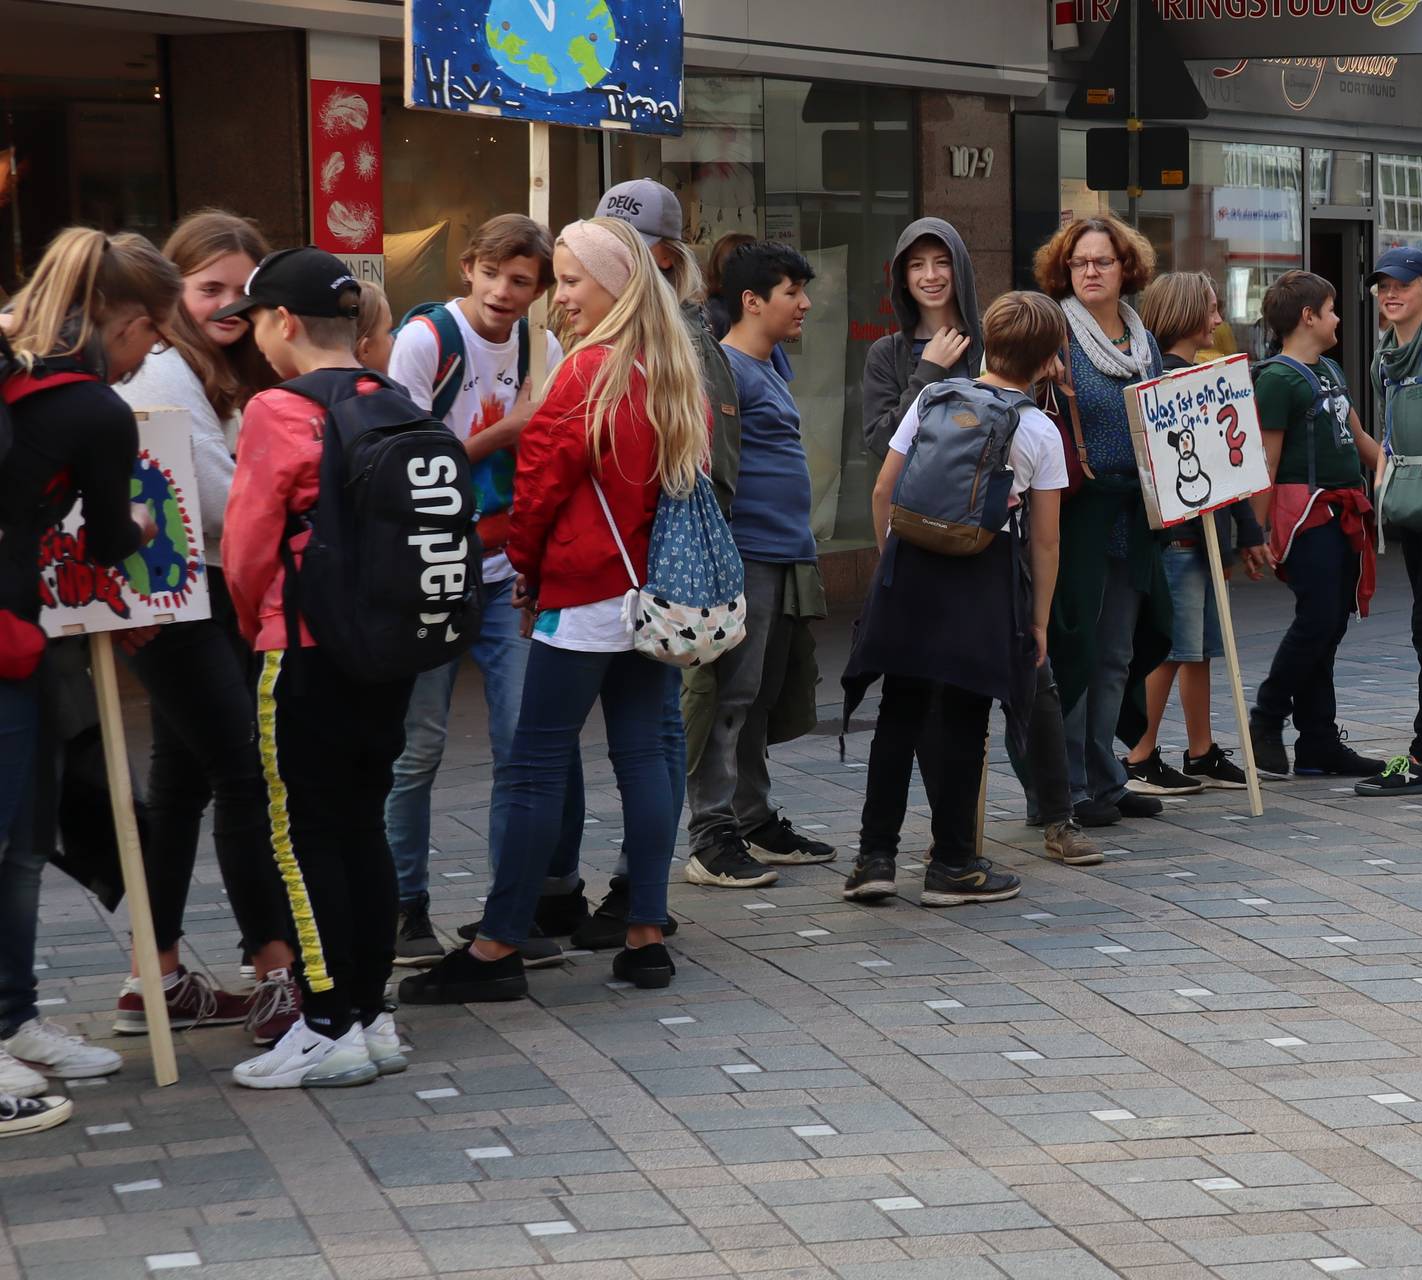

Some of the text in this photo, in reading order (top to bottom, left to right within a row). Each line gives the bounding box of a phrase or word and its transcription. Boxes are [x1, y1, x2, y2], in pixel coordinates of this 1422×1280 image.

[1339, 79, 1397, 98] DORTMUND
[949, 146, 993, 178] 107-9
[607, 195, 643, 215] DEUS
[1144, 385, 1176, 423] Was
[1176, 390, 1193, 412] ist
[1196, 384, 1216, 406] ein
